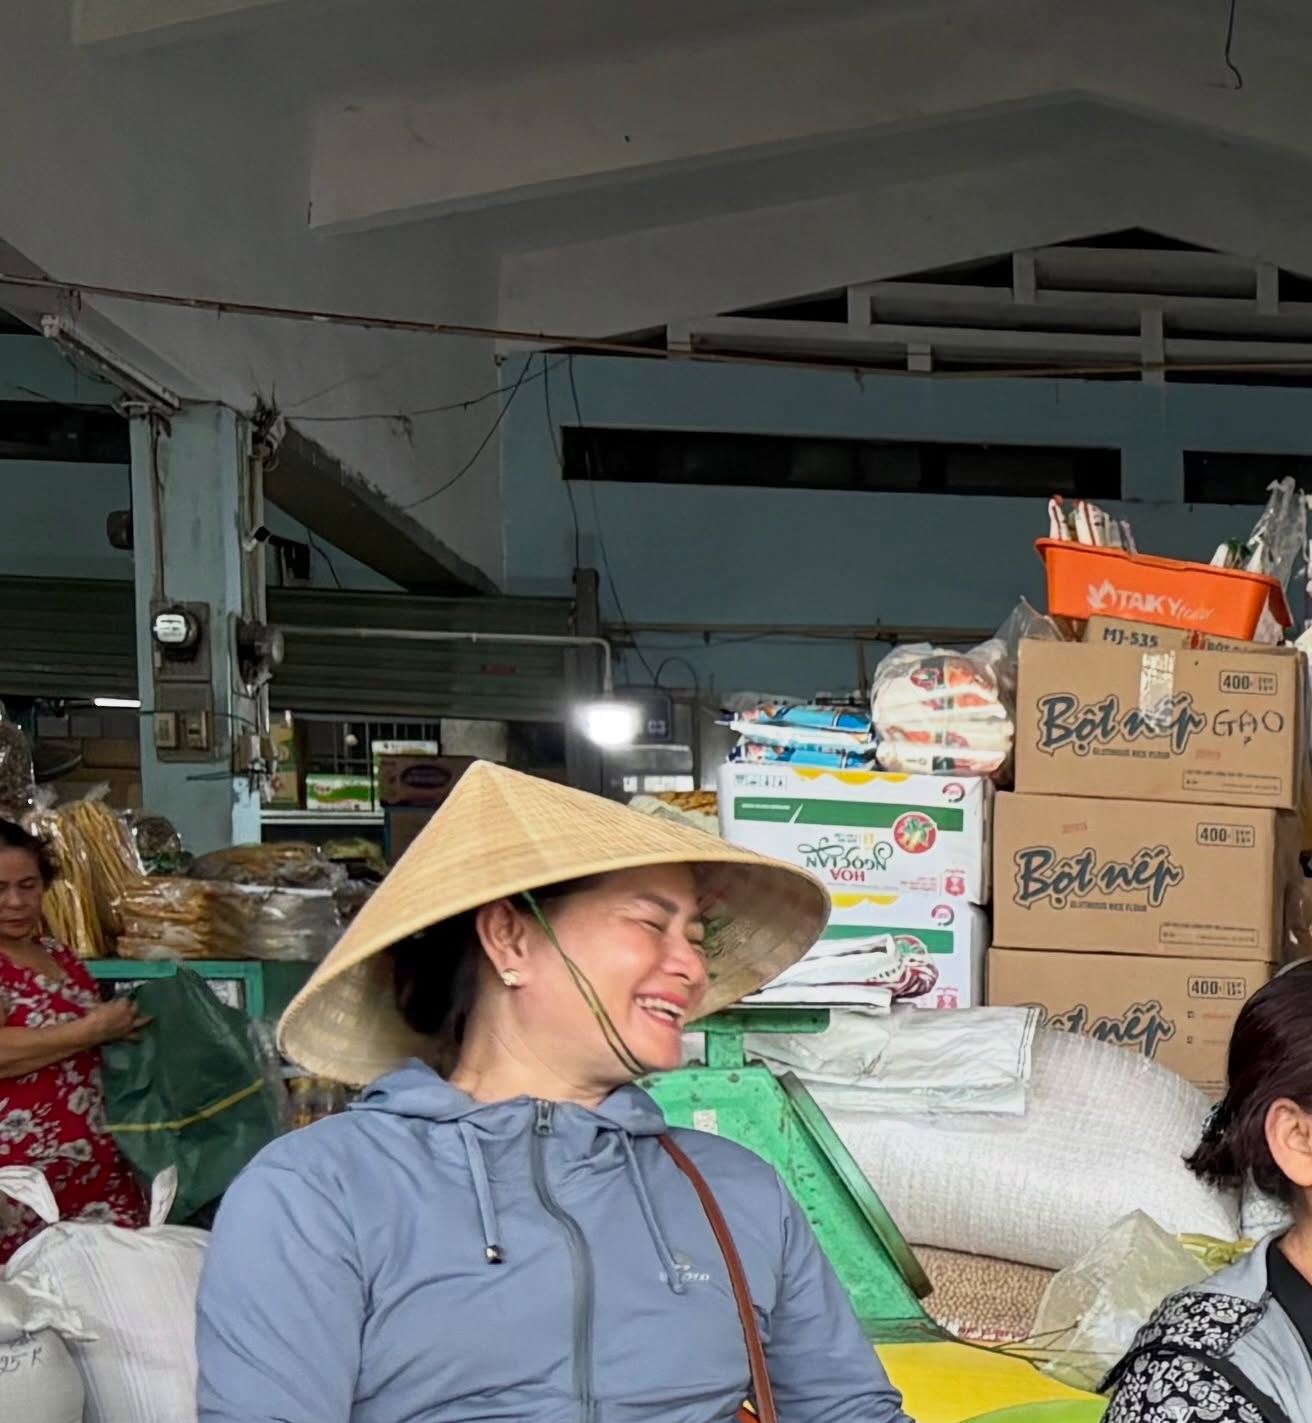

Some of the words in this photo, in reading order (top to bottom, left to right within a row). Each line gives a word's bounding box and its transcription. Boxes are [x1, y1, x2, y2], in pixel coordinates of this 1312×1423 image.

[1103, 626, 1159, 647] MJ-535
[1041, 695, 1116, 752] Bột
[1212, 708, 1284, 744] GẠO
[830, 868, 865, 882] HOA
[1018, 849, 1093, 905] Bột
[1100, 848, 1181, 904] nếp
[1093, 1002, 1173, 1058] nếp
